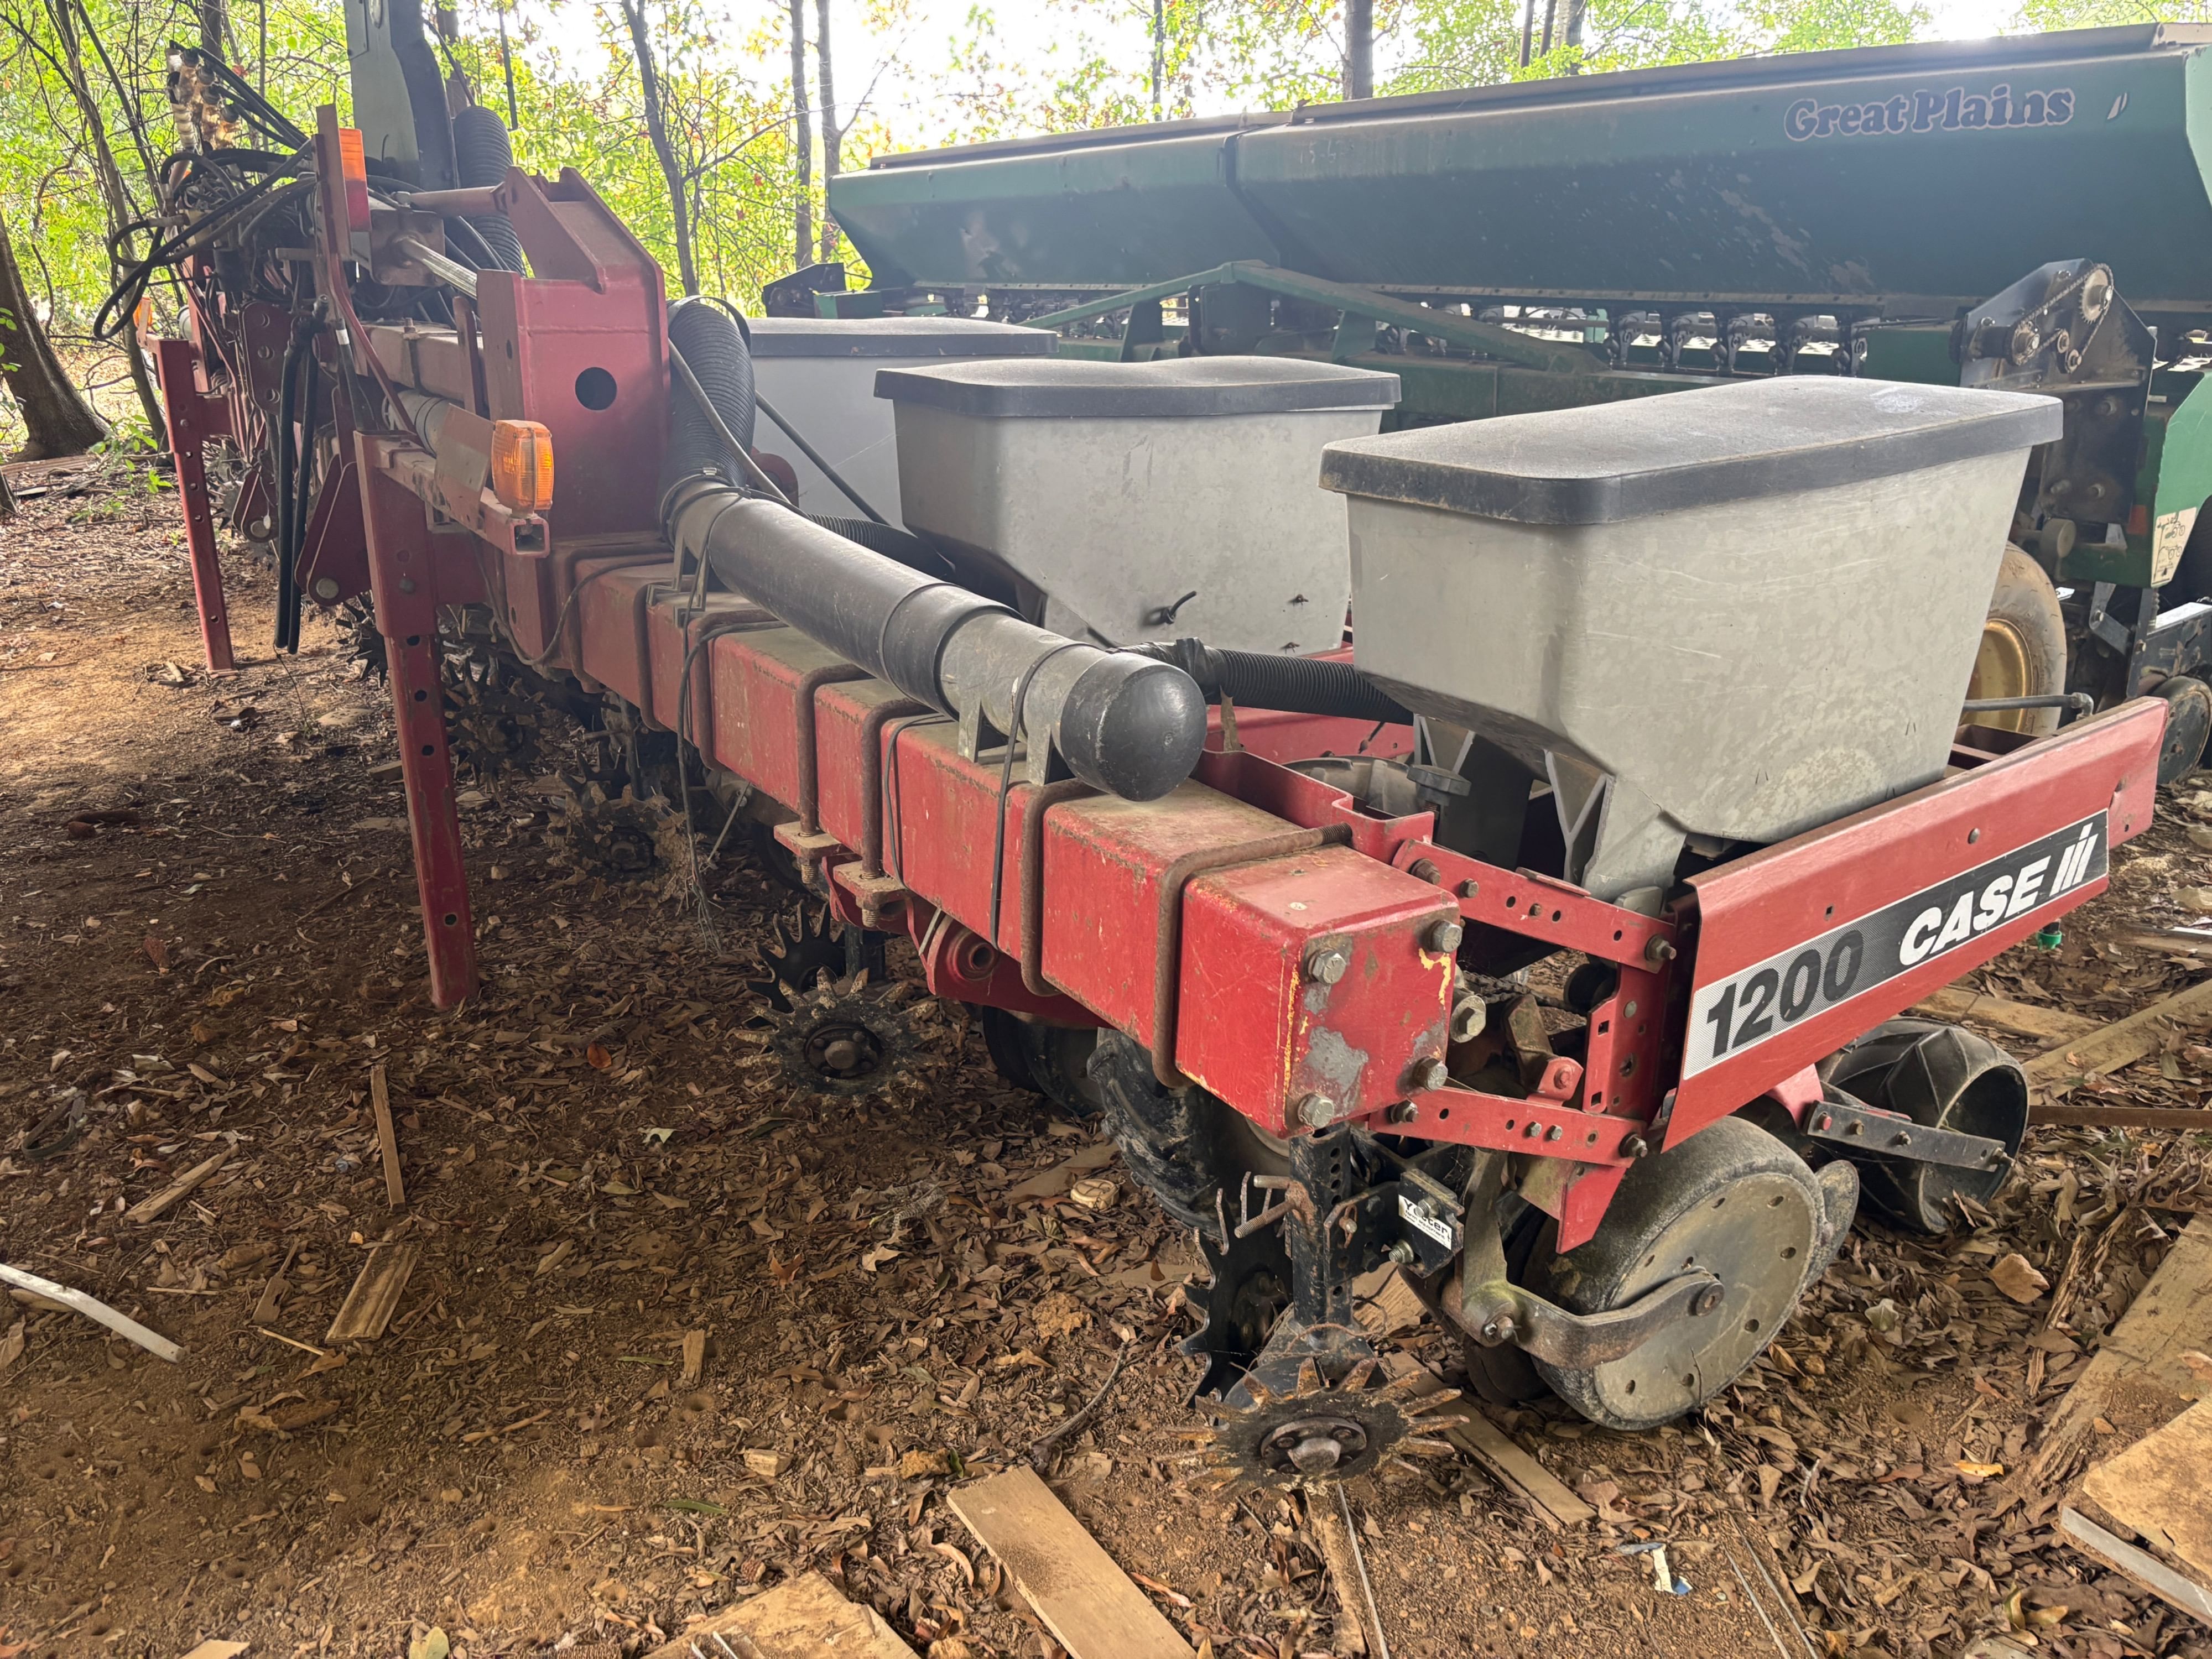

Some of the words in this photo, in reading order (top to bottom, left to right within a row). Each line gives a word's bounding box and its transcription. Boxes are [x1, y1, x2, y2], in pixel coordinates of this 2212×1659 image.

[1784, 95, 1908, 142] Great
[1910, 84, 2075, 133] Plains
[1707, 930, 1864, 1058] 1200
[1899, 855, 2052, 966] CASE
